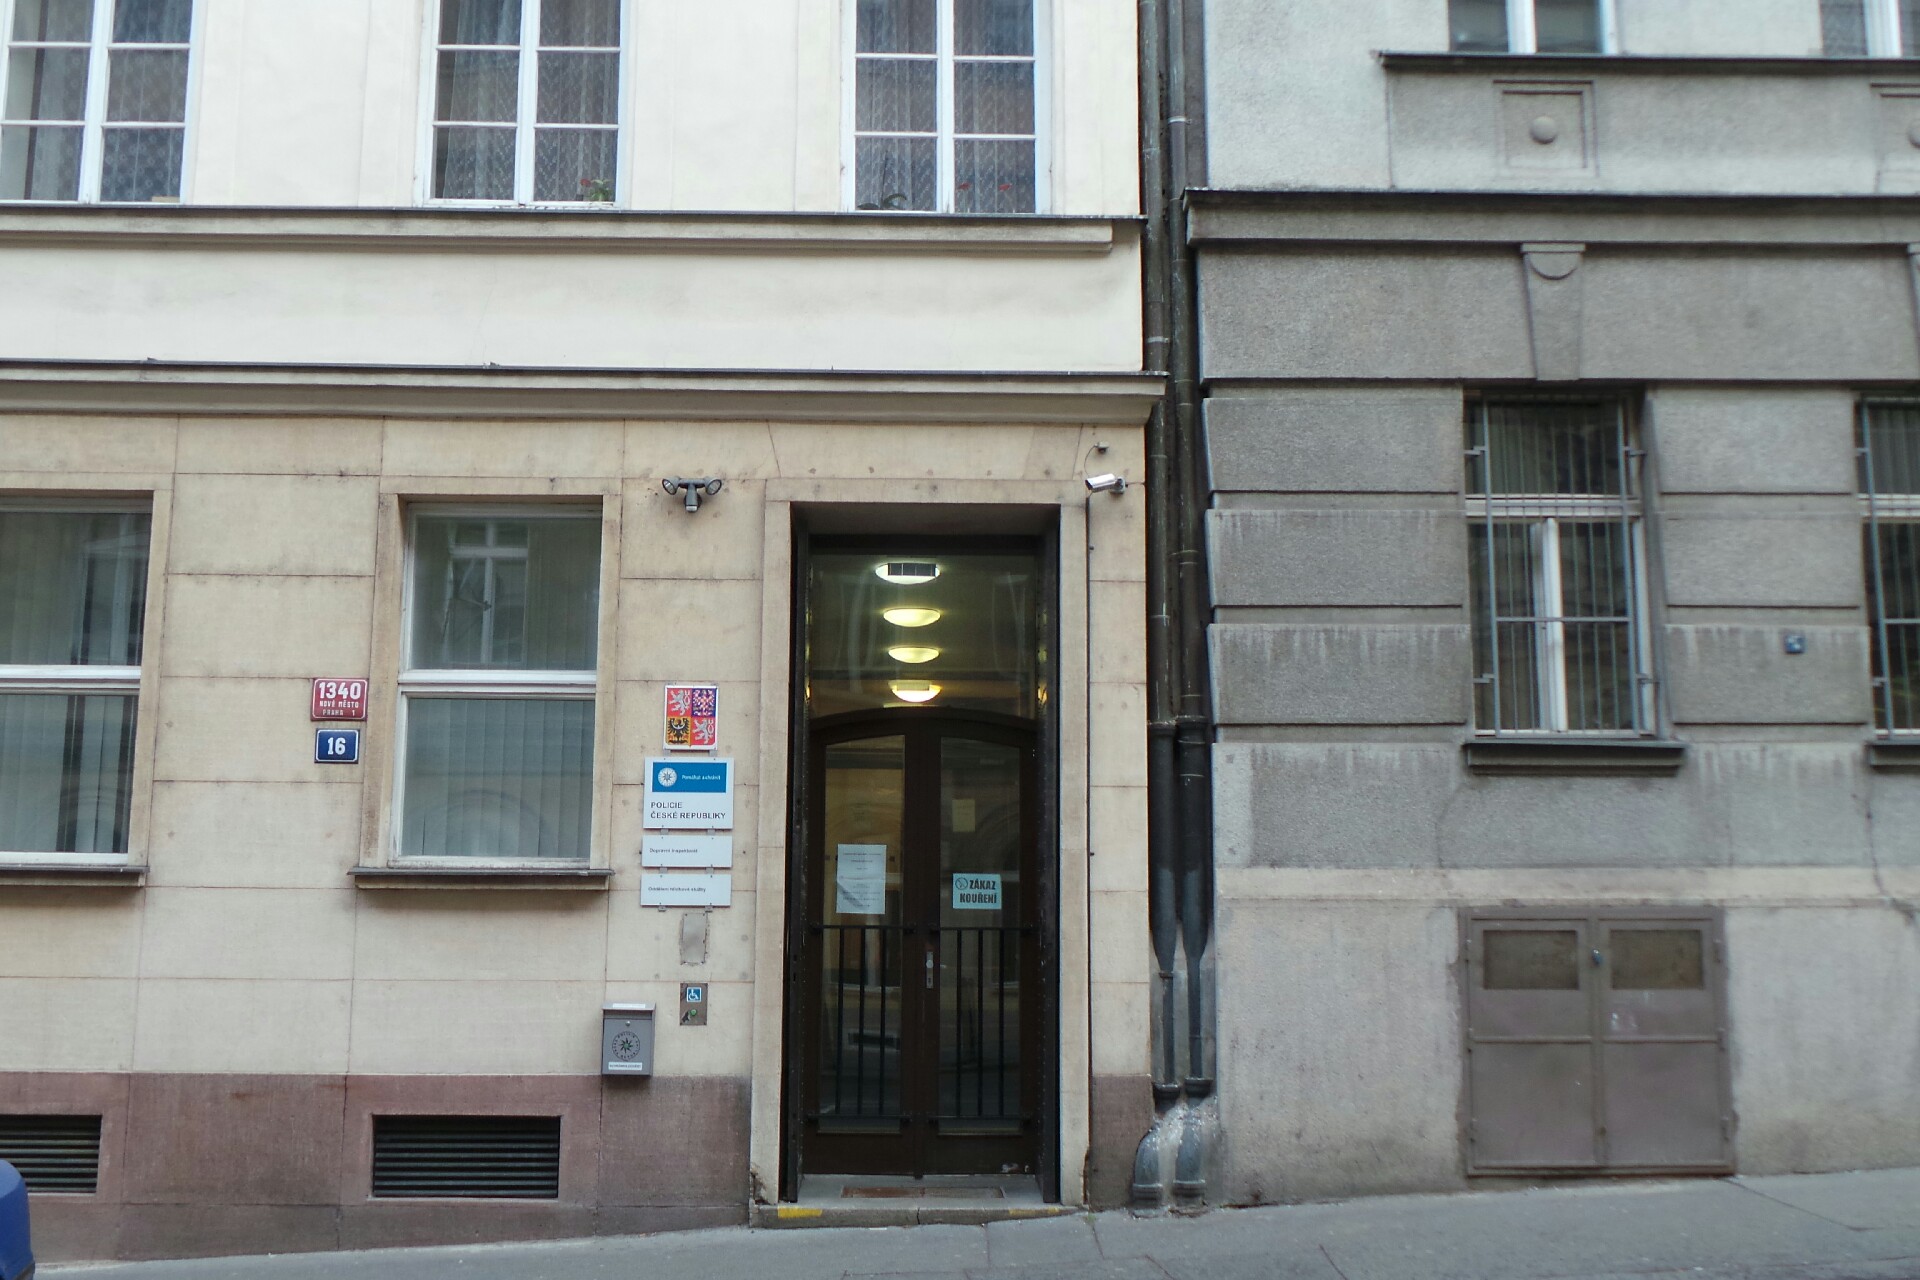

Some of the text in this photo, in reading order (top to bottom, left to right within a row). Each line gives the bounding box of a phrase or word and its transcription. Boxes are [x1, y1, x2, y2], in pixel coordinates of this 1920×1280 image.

[318, 681, 362, 700] 1340
[319, 700, 359, 709] NOVÉ MĚSTO
[322, 709, 356, 717] PRAHA 1
[327, 737, 346, 755] 16
[650, 801, 683, 809] POLICIE
[650, 811, 678, 819] ČESKÉ
[969, 878, 996, 890] ZÁKAZ
[959, 892, 997, 904] KOUŘENÍ
